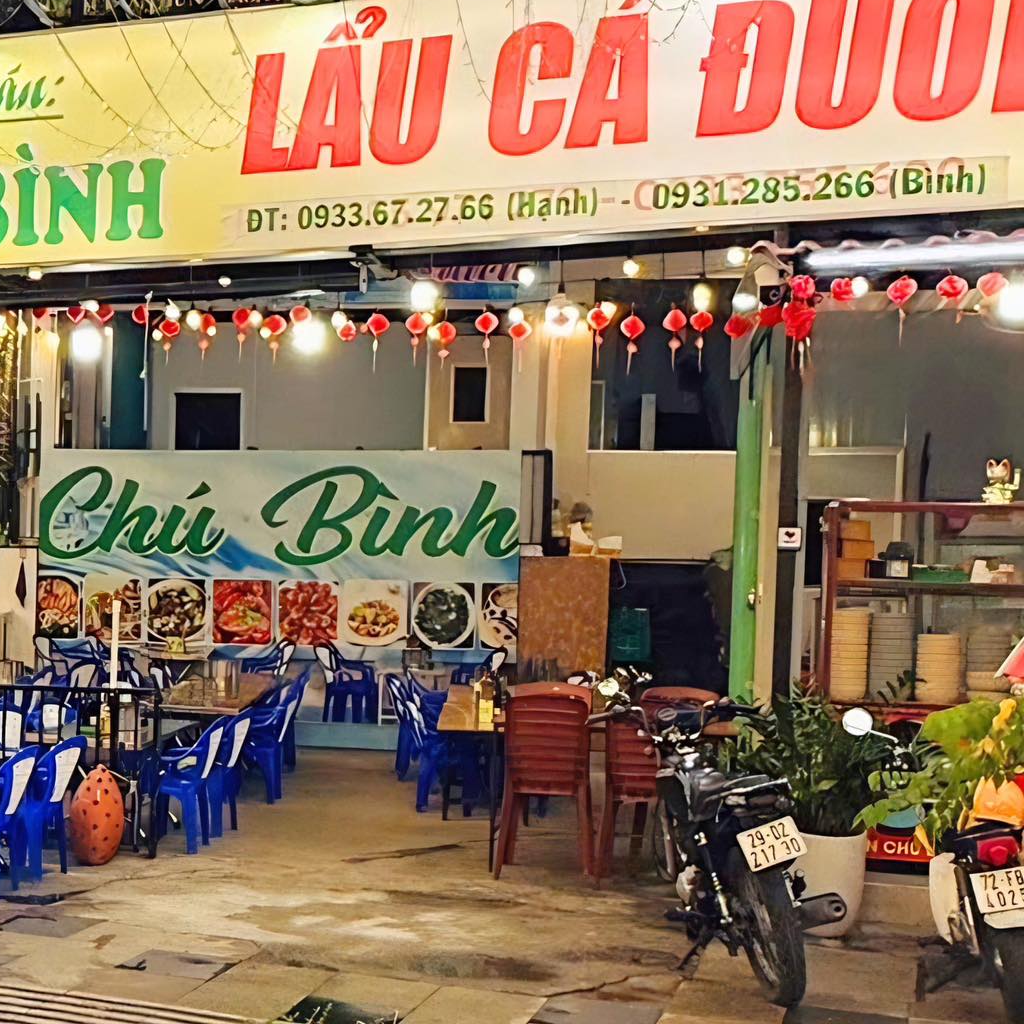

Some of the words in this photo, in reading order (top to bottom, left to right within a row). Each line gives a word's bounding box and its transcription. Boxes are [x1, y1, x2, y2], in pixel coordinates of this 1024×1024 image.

[240, 5, 454, 175] LẨU
[246, 206, 288, 234] ĐT:
[297, 192, 495, 231] 0933.67.27.66
[506, 185, 598, 223] (Hạnh)
[652, 169, 876, 211] 0931.285.266
[888, 162, 987, 200] (Bình)
[39, 465, 227, 560] Chú
[260, 464, 520, 566] Bình
